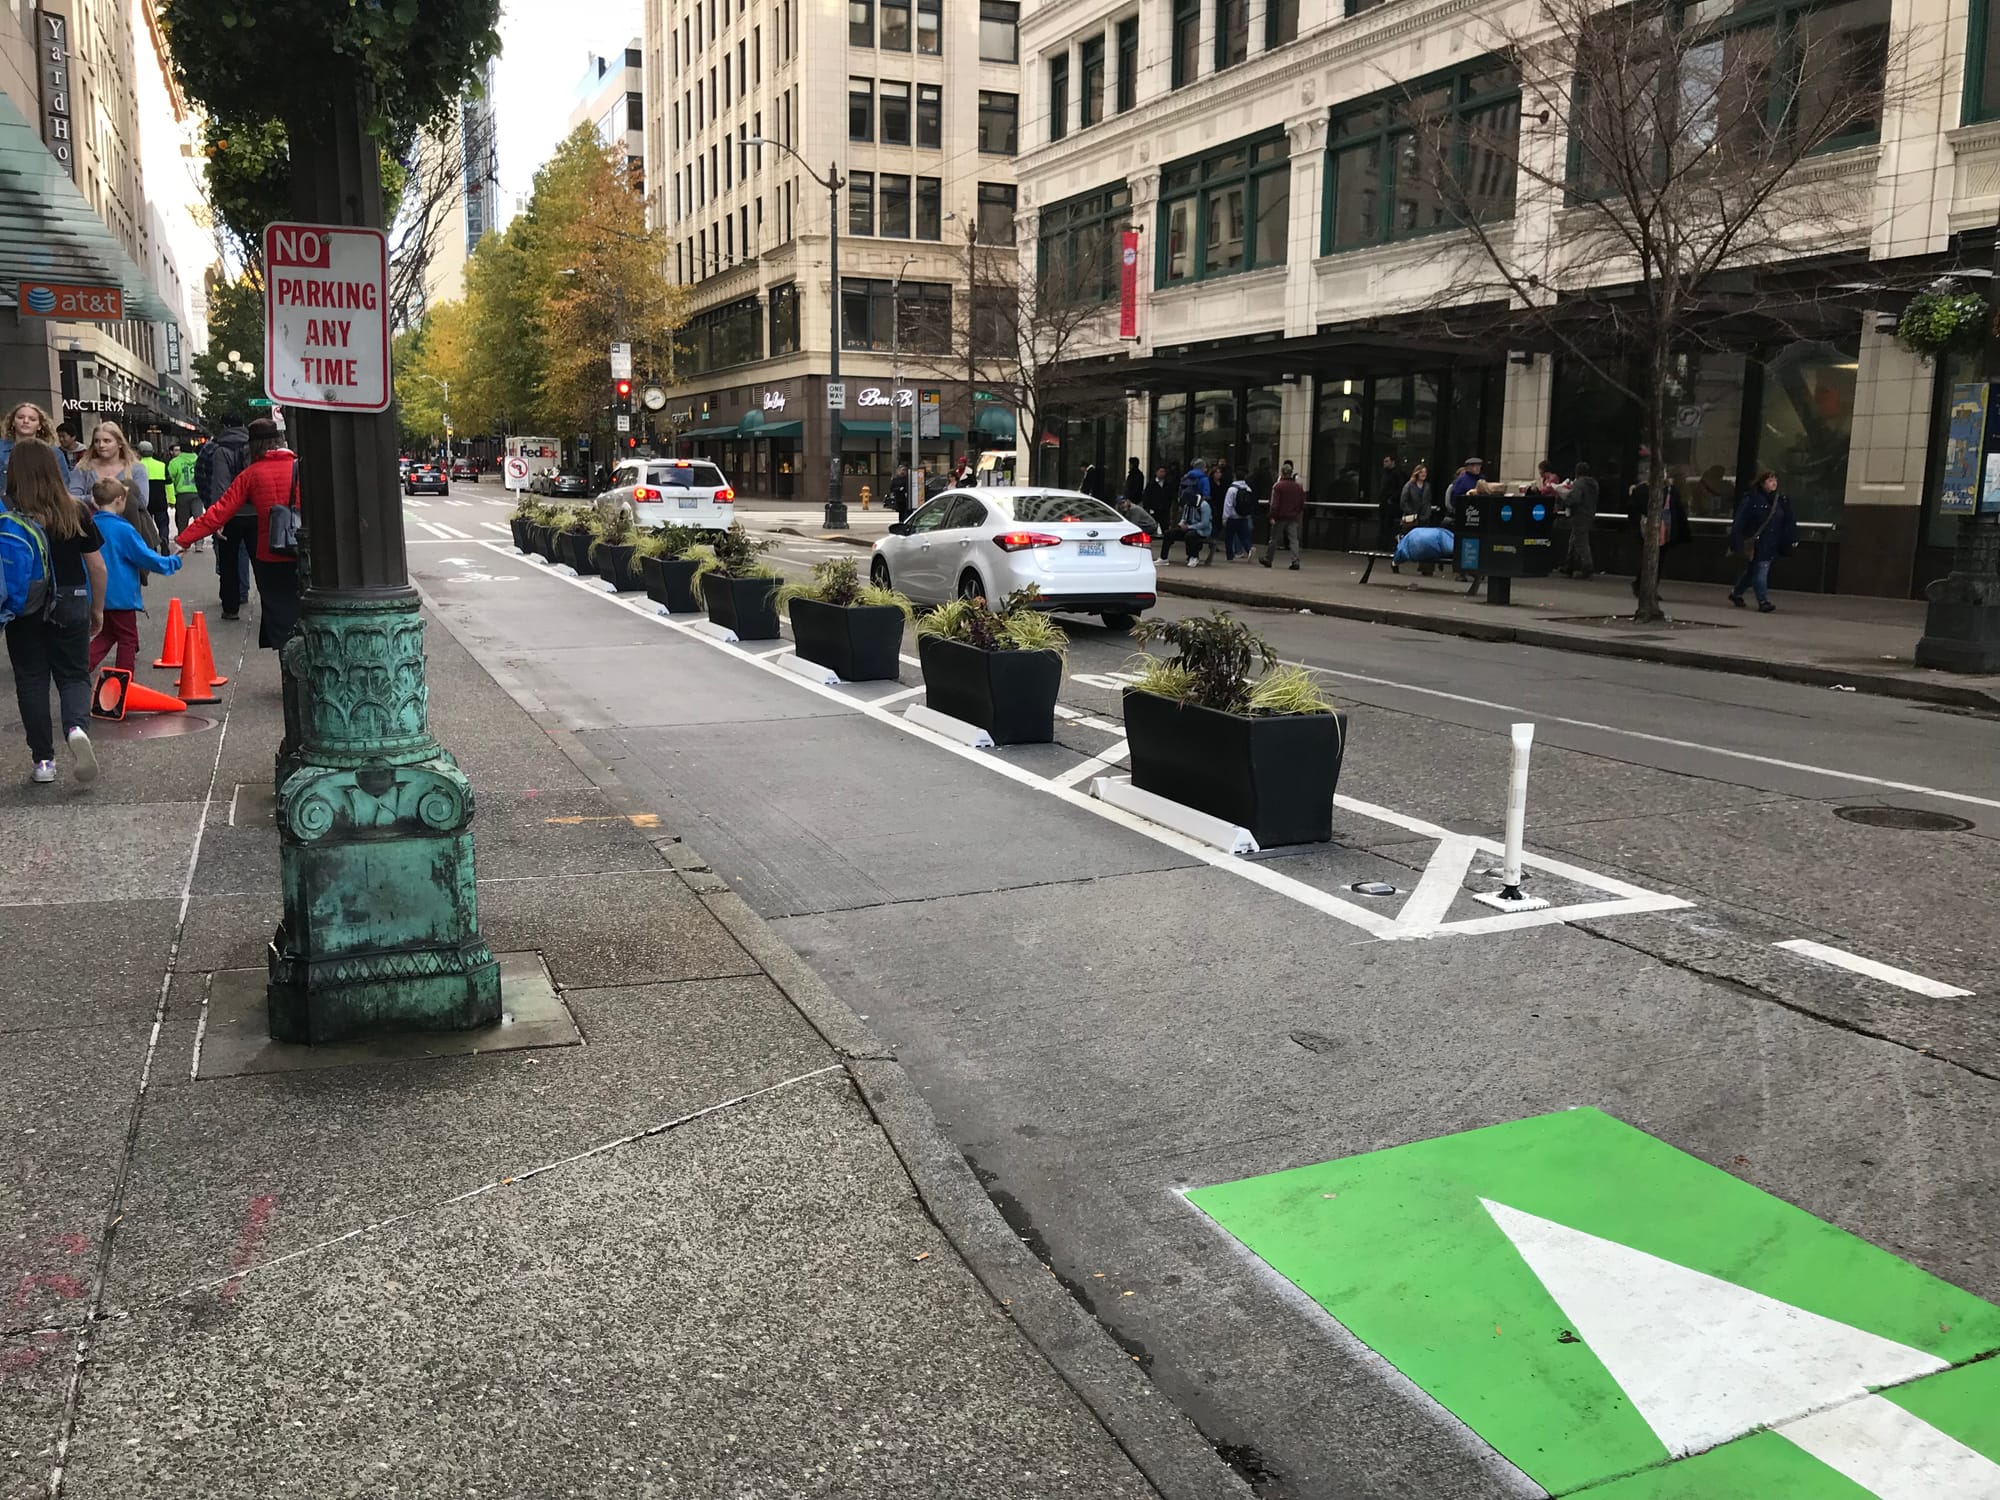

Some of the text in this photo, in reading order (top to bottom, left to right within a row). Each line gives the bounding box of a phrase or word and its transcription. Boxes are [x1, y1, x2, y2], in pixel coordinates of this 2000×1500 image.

[48, 18, 69, 177] Yard Ho
[275, 230, 321, 263] NO
[61, 291, 117, 313] at&t
[278, 278, 377, 311] PARKING
[305, 318, 351, 348] ANY
[300, 357, 358, 387] TIME
[857, 388, 890, 406] Ben
[520, 445, 558, 458] FedEx
